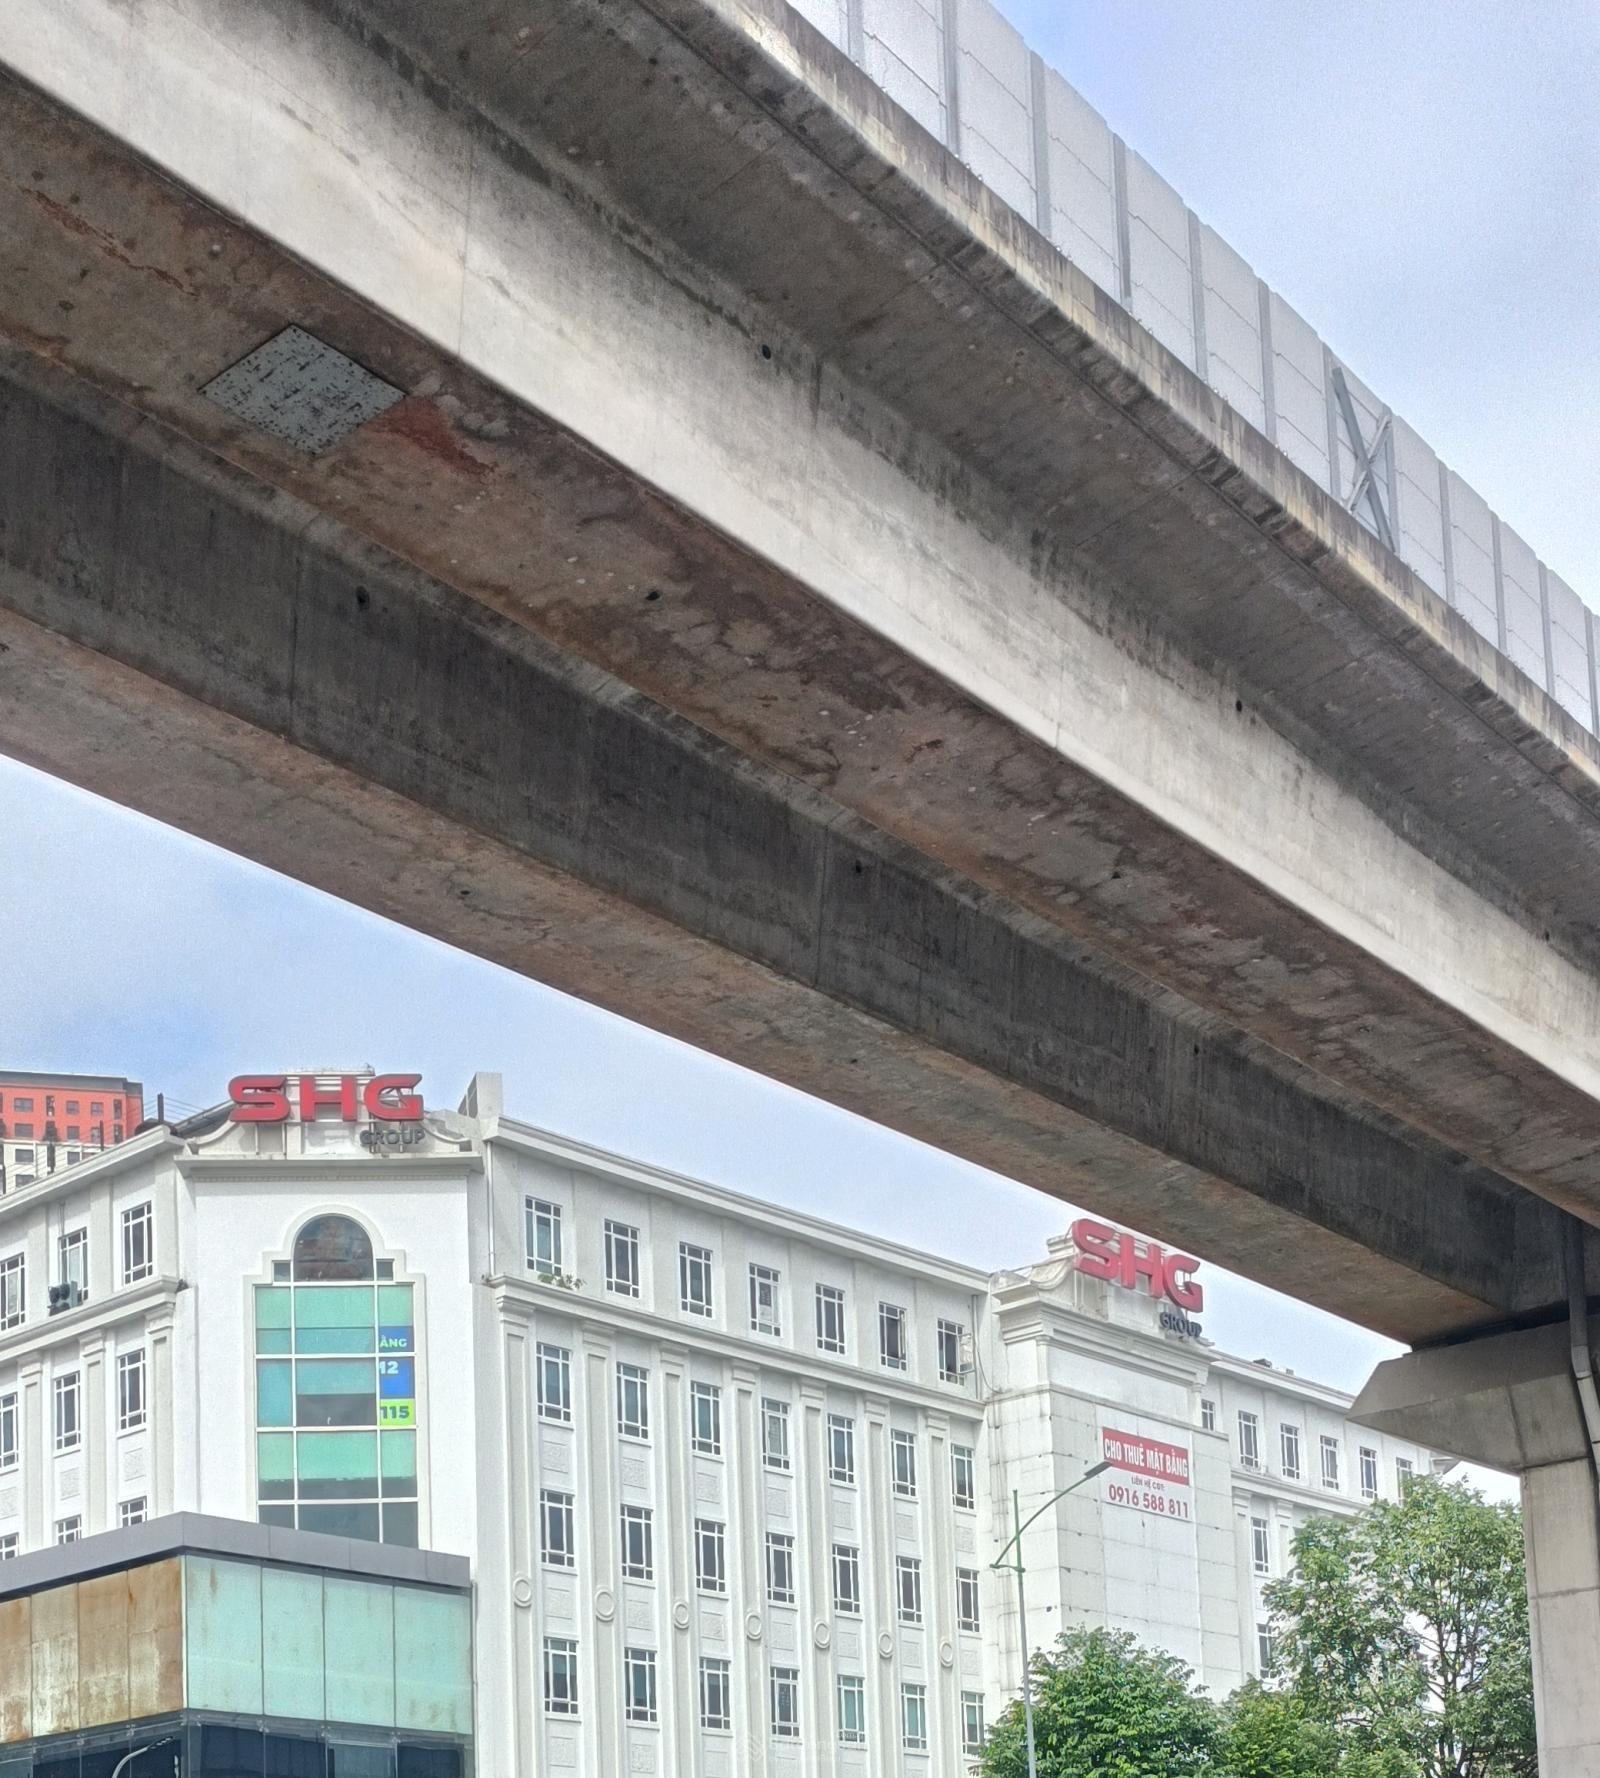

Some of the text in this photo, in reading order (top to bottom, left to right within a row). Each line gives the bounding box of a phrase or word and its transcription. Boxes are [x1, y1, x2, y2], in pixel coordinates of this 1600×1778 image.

[228, 1073, 424, 1122] SHG
[360, 1129, 425, 1146] GROUP
[1072, 1218, 1204, 1313] SHG
[1159, 1311, 1203, 1338] GROUP
[1104, 1438, 1188, 1478] CHO THUÊ MẶT BẰNG
[1109, 1484, 1188, 1518] 0916 588 811
